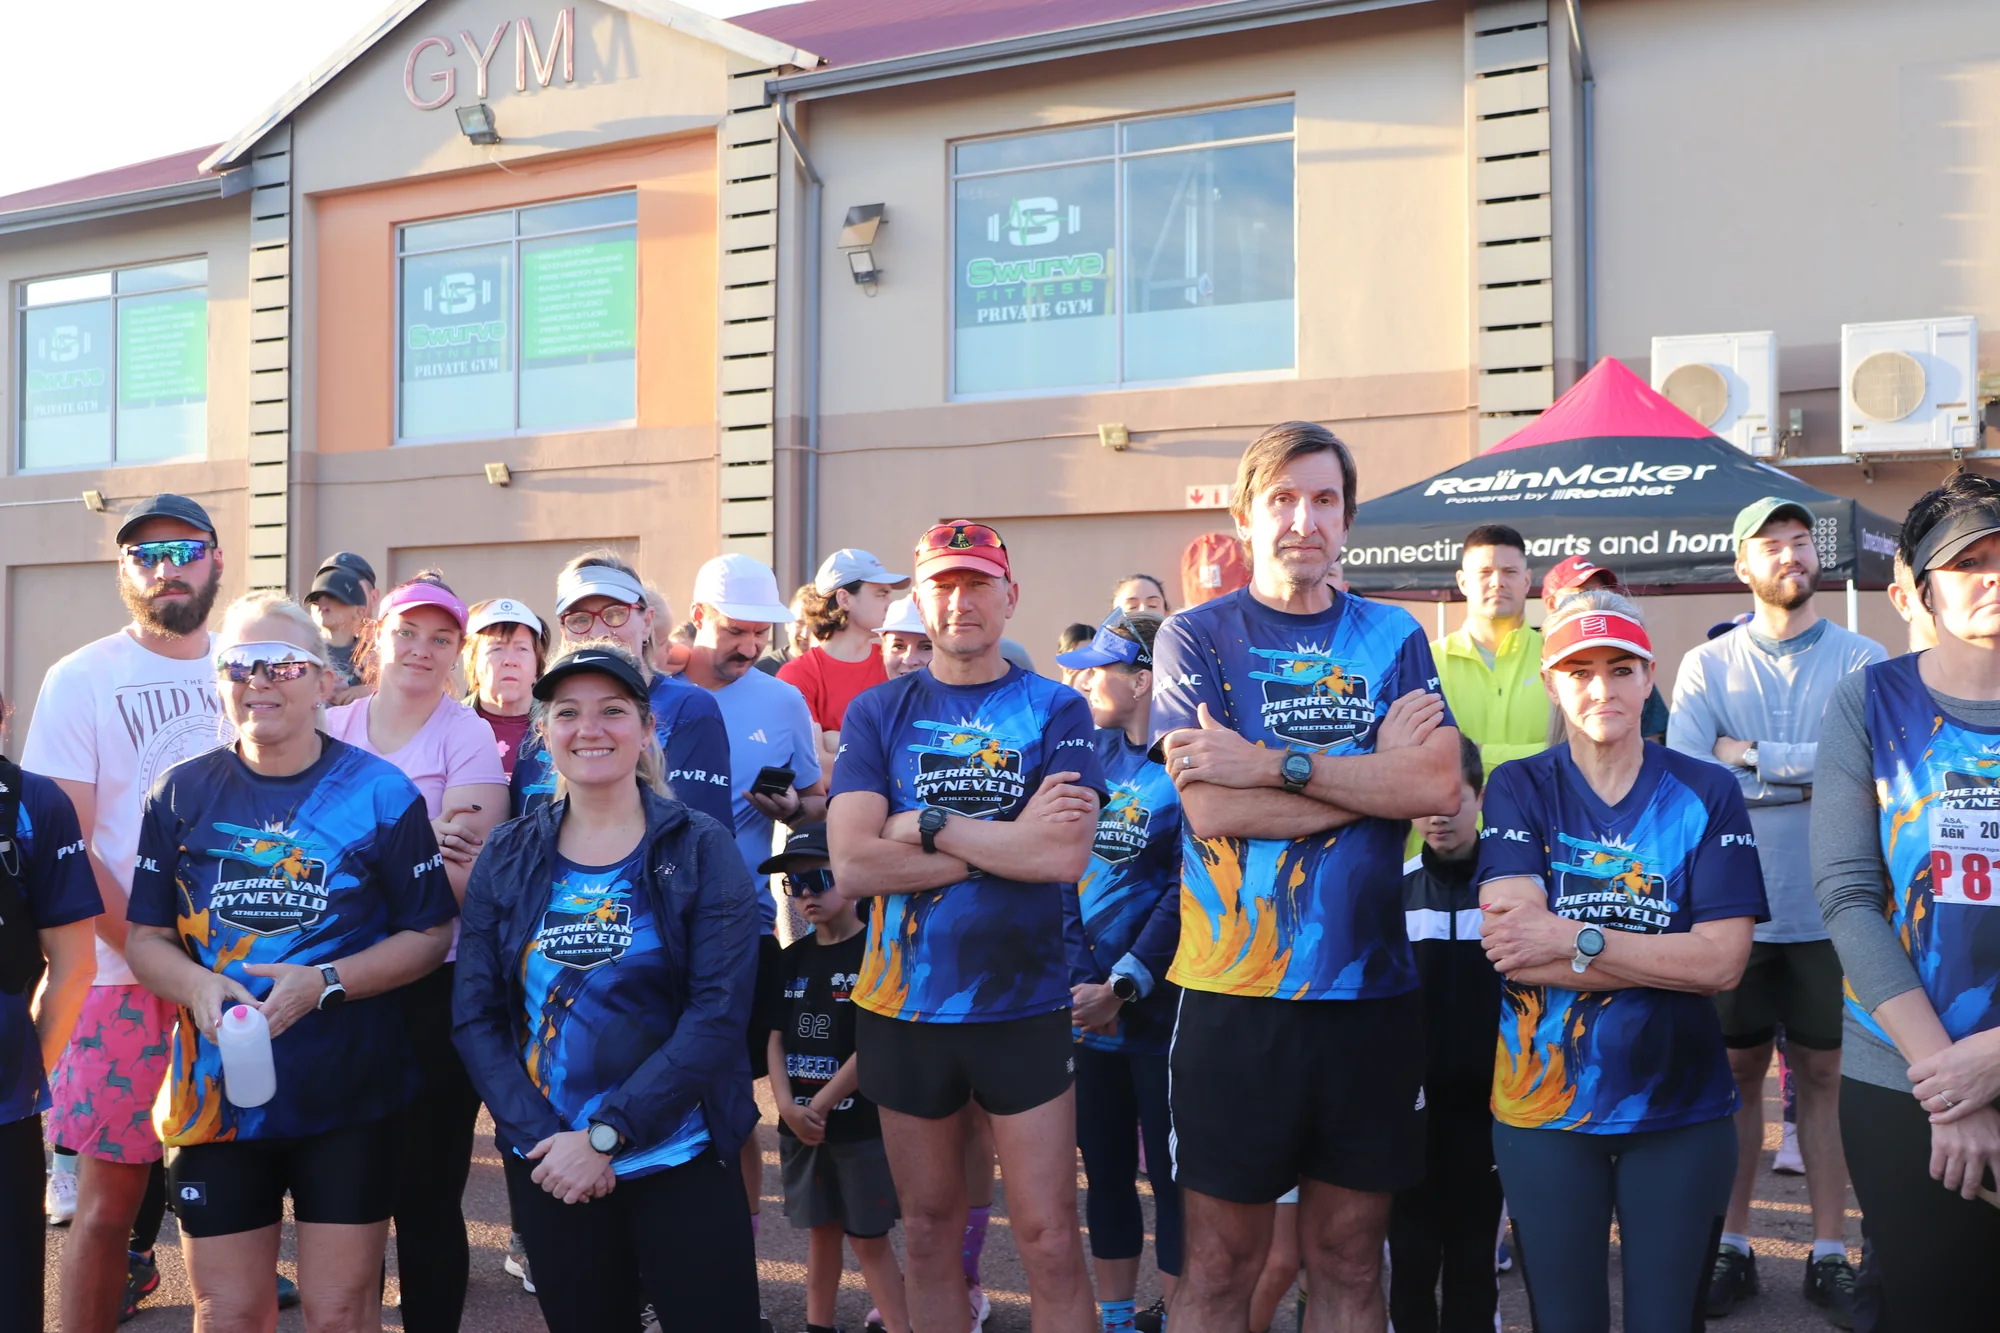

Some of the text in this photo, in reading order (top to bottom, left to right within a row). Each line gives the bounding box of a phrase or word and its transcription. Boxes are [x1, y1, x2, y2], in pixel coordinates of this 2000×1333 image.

[404, 7, 575, 111] GYM
[967, 253, 1104, 287] Swurve
[976, 280, 1093, 302] FITNESS
[977, 298, 1093, 323] PRIVATE GYM
[409, 320, 507, 350] Swurve
[414, 357, 499, 378] PRIVATE GYM
[77, 399, 98, 411] GYM
[1424, 462, 1717, 496] RainMaker
[1445, 484, 1675, 505] Powered by RealNet
[1524, 532, 1591, 558] earts
[1599, 530, 1659, 555] and
[1666, 529, 1736, 554] hom
[1178, 673, 1202, 686] AC
[1260, 696, 1375, 714] PIERRE VAN
[115, 687, 191, 759] WILD
[1264, 708, 1376, 729] RYNEVELD
[1288, 723, 1356, 732] ATHLETICS CLUB
[709, 774, 729, 787] AC
[913, 768, 1026, 785] PIERRE VAN
[916, 779, 1025, 799] RYNEVELD
[1093, 831, 1147, 849] YNEVELD
[1096, 821, 1150, 838] ERRE VAN
[1503, 828, 1531, 843] AC
[1941, 828, 1965, 839] AGN
[1931, 850, 2000, 901] P 8
[210, 878, 330, 898] PIERRE VAN
[209, 891, 328, 912] RYNEVELD
[1555, 892, 1671, 913] PIERRE VAN
[231, 909, 303, 918] ATHLETICS CLUB
[1557, 905, 1671, 928] RYNEVELD
[536, 923, 634, 940] PIERRE VAN
[536, 933, 633, 952] RYNEVELD
[797, 1012, 831, 1039] 92
[786, 1053, 839, 1074] SPEED
